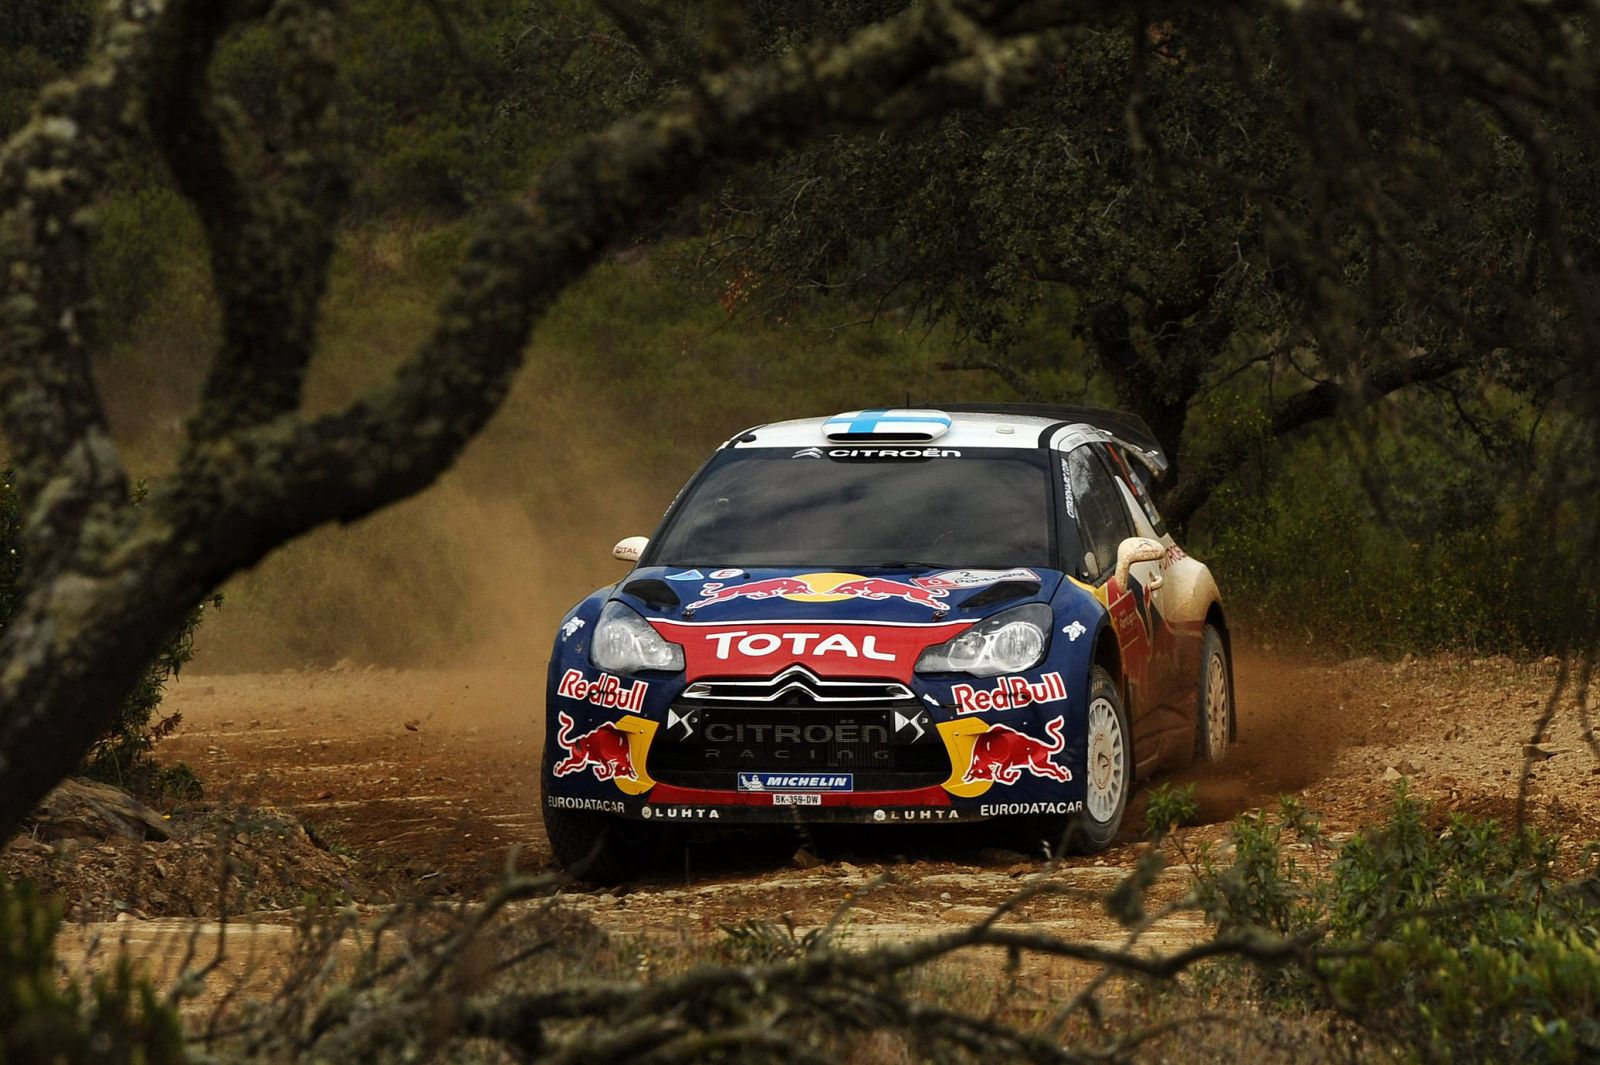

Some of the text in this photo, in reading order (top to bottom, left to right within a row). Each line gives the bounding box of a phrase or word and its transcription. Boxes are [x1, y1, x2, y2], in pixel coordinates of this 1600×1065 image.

[705, 631, 896, 661] TOTAL
[705, 749, 889, 759] RACING
[766, 776, 848, 787] MICHELIN
[775, 795, 819, 804] BK-359-DW
[548, 796, 625, 814] EURODATACAR
[980, 800, 1083, 816] EURODATACAR
[655, 809, 720, 819] LUHTA
[890, 810, 960, 820] LUHTA
